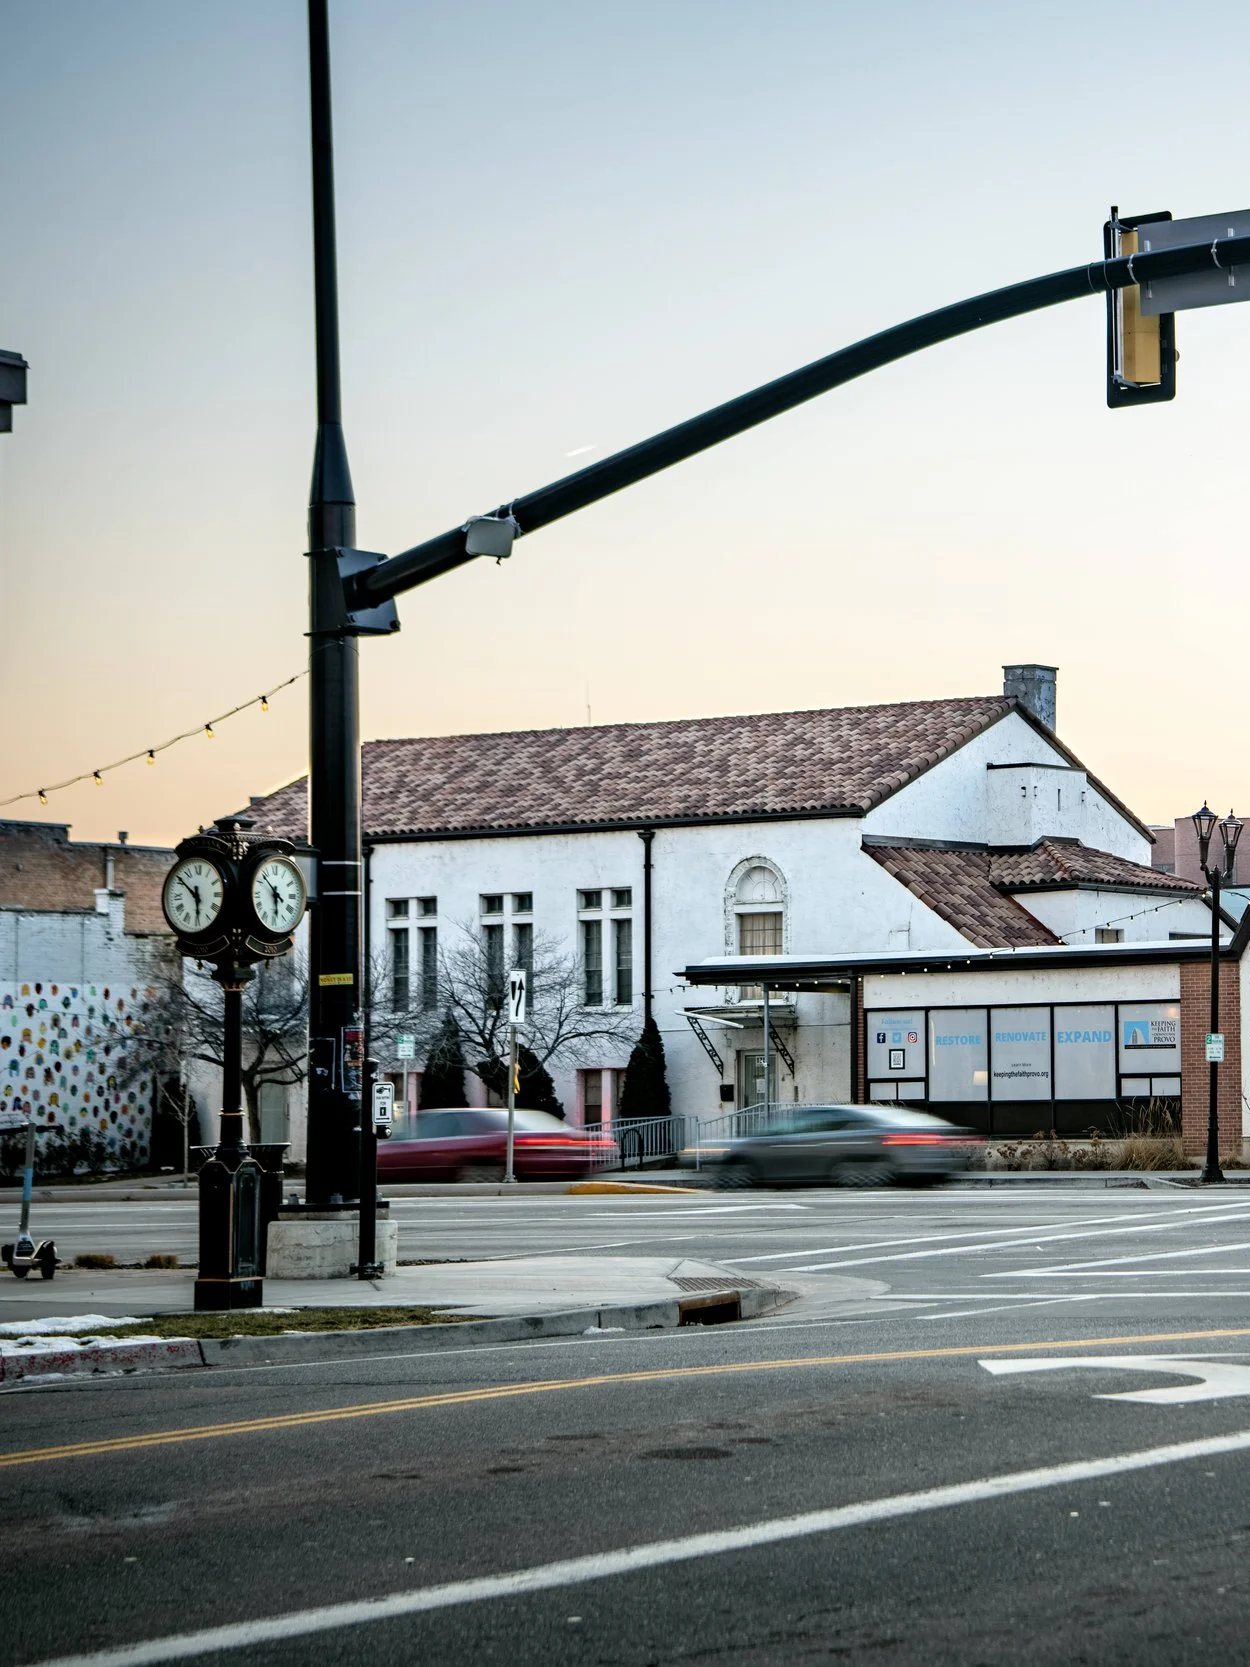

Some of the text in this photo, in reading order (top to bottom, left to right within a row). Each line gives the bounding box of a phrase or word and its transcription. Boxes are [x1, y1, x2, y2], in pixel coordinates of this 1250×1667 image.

[935, 1035, 981, 1045] RESTORE
[995, 1031, 1047, 1042] RENOVATE
[1057, 1031, 1113, 1043] EXPAND
[993, 1070, 1049, 1079] keepingthefaithprovo.org
